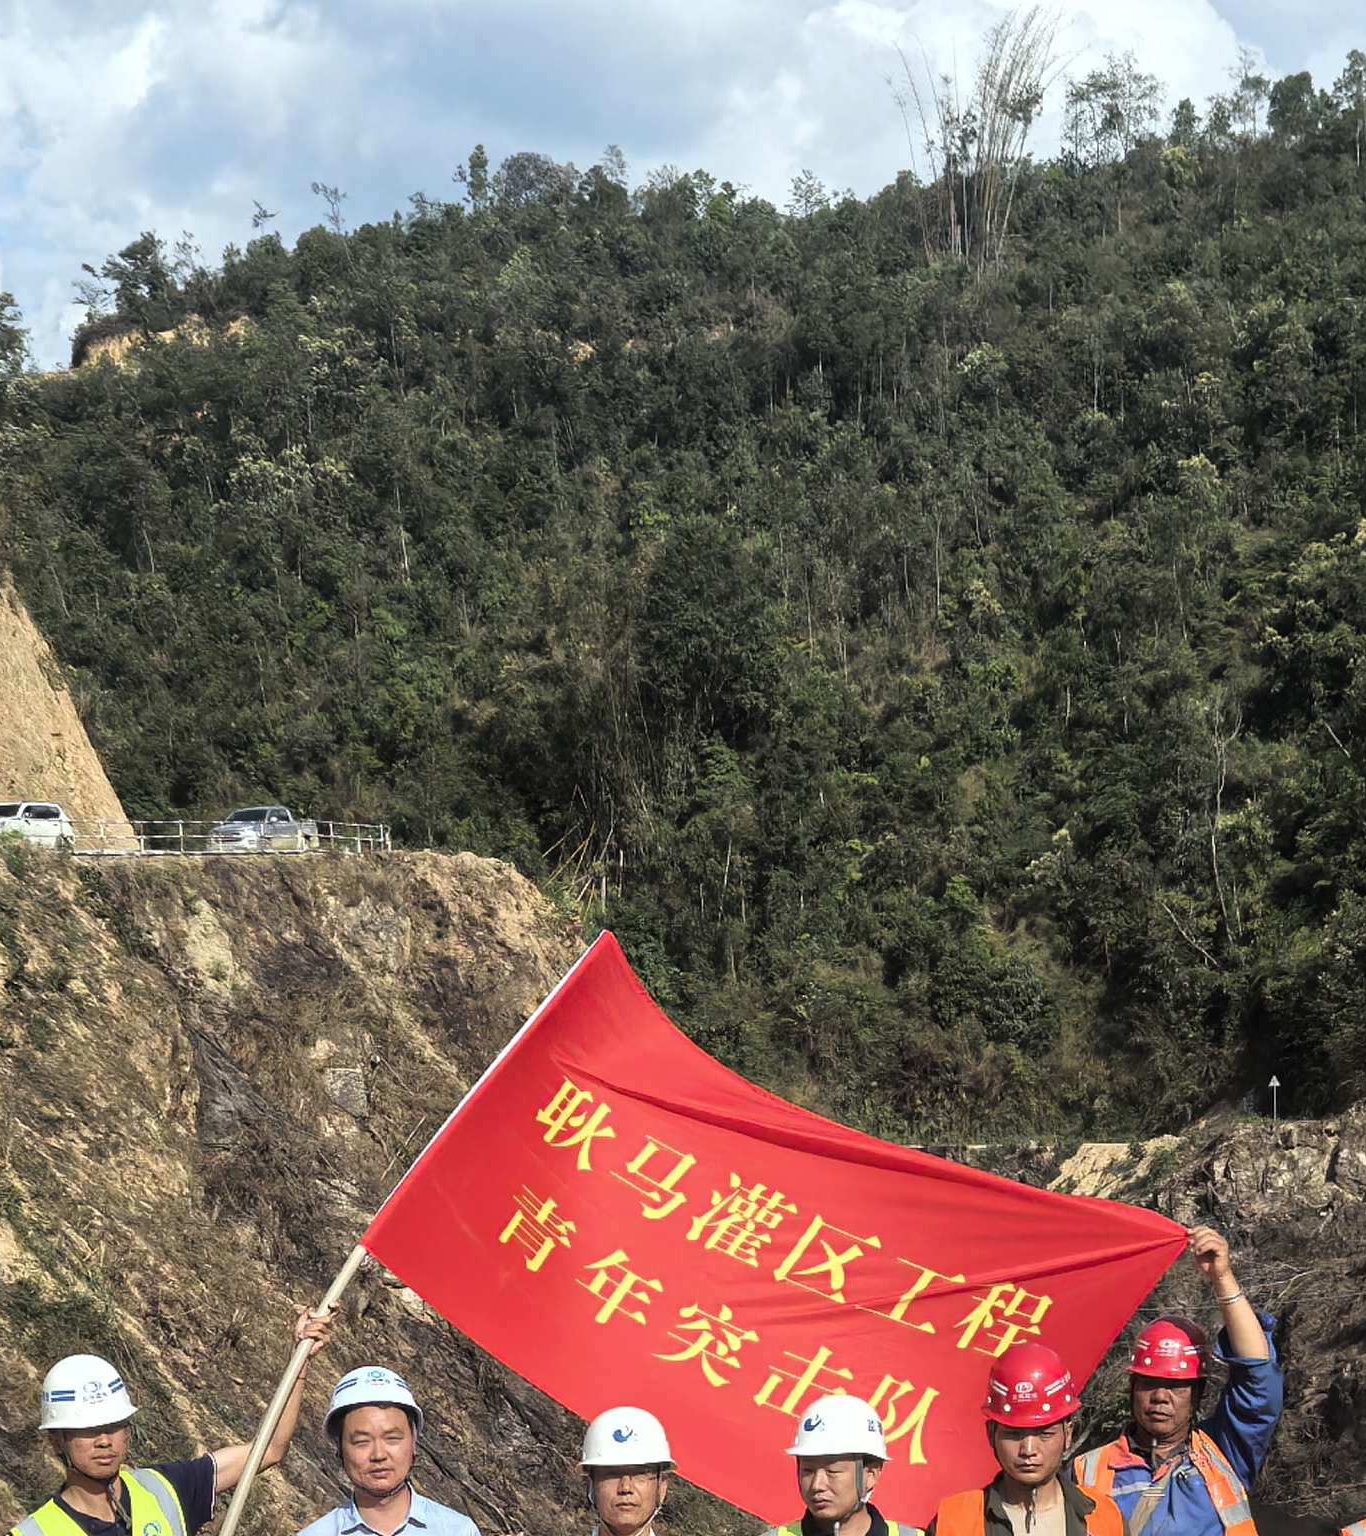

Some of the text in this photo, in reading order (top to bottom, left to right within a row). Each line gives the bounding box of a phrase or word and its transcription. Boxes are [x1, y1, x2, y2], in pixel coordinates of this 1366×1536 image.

[498, 1184, 941, 1465] 青年突击队
[535, 1076, 1053, 1358] 耿马灌区工程
